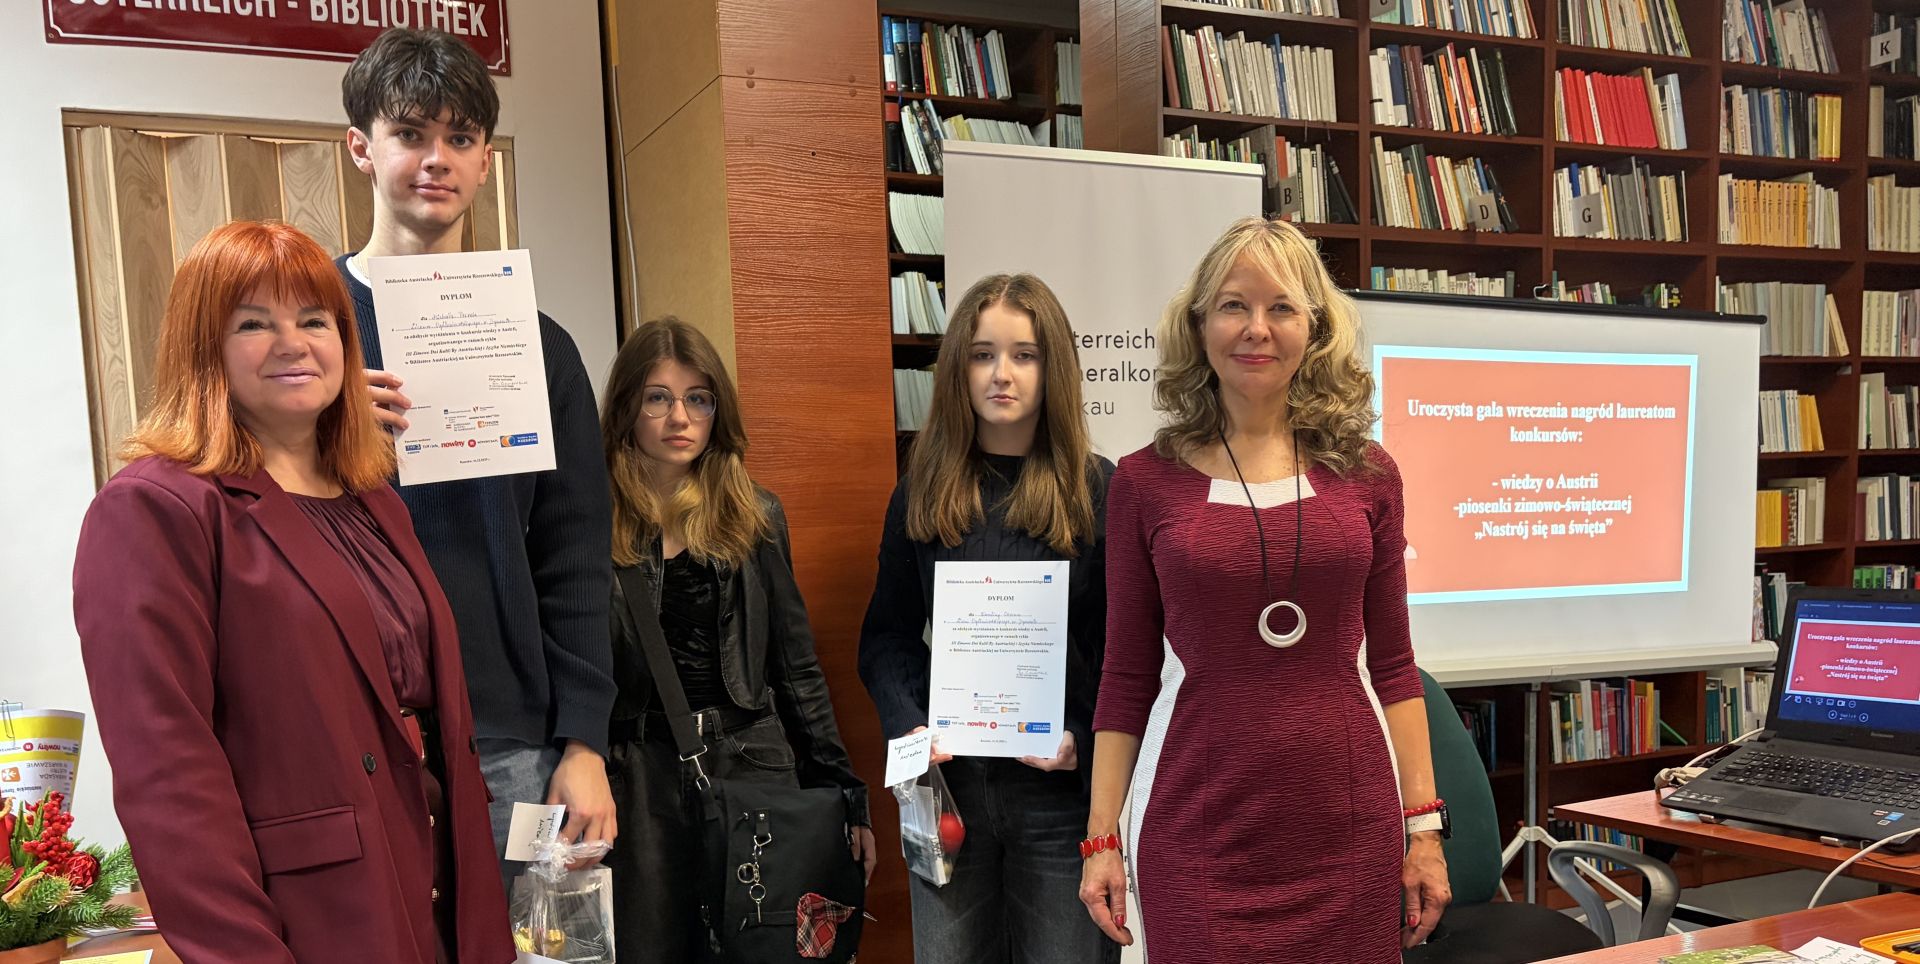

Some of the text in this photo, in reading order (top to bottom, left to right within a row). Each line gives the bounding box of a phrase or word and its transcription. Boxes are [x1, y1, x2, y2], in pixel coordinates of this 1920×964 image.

[69, 0, 276, 18] REICH
[310, 0, 488, 37] BIBLIOTHEK
[1880, 40, 1890, 56] K
[1284, 187, 1291, 204] B
[1479, 204, 1489, 220] D
[1582, 207, 1592, 223] G
[440, 292, 472, 301] DYPLOM
[1073, 328, 1155, 349] terreich
[1081, 361, 1157, 382] eralko
[1082, 401, 1114, 415] kau
[1408, 399, 1473, 420] Uroczysta
[1477, 401, 1503, 421] gala
[1571, 403, 1613, 422] nagród
[1617, 403, 1676, 419] laureatom
[1510, 426, 1583, 443] konkursów:
[441, 440, 465, 448] nowiny
[1501, 473, 1543, 493] wiedzy
[1546, 478, 1554, 489] o
[1556, 473, 1598, 489] Austrii
[1453, 495, 1632, 518] -piosenki zimowo-świątecznej
[1474, 518, 1613, 540] „Nastrój się na święta”
[1807, 633, 1833, 641] Uroczysta
[1846, 642, 1878, 650] konkursów:
[1840, 657, 1858, 665] wiedzy
[1864, 658, 1883, 666] Austrii
[967, 720, 988, 728] nowiny
[38, 743, 61, 751] nowiny
